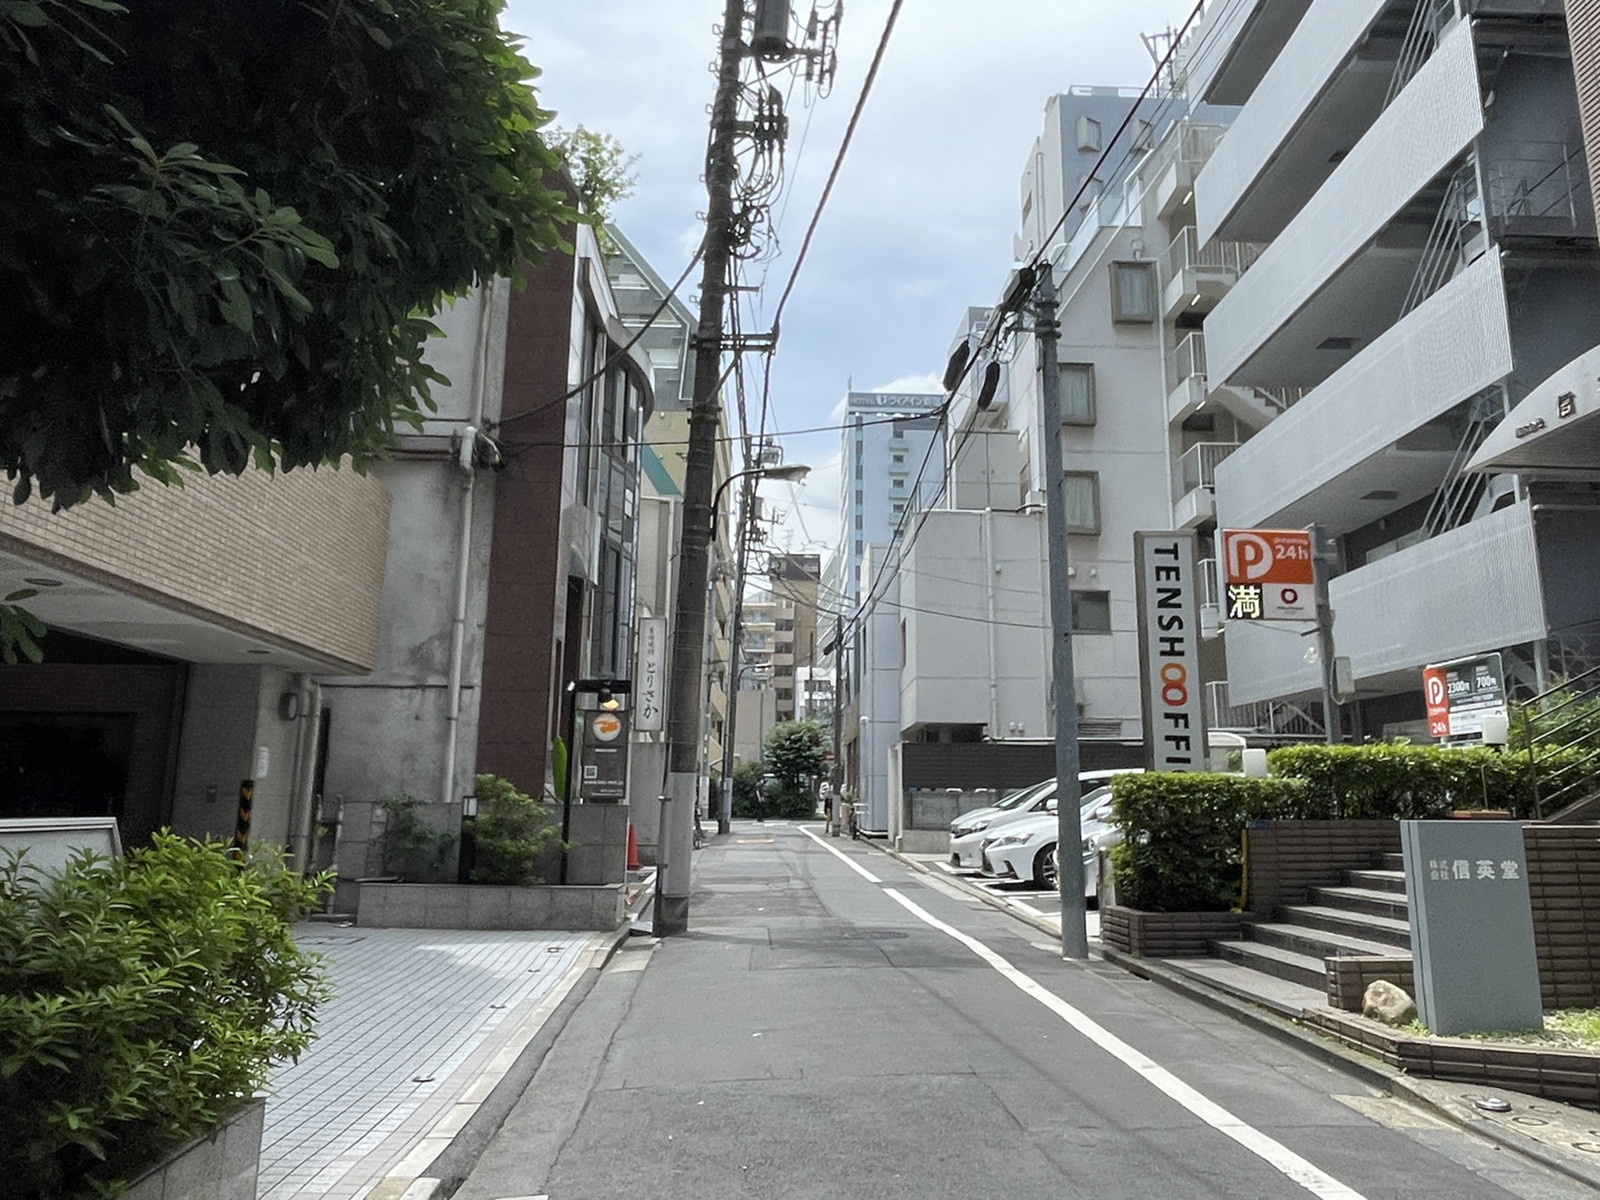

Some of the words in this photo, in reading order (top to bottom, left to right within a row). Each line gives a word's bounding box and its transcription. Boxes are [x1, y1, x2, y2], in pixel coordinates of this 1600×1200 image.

[1228, 533, 1273, 579] P
[1275, 544, 1309, 560] 24h
[1228, 585, 1261, 619] 満
[1153, 542, 1191, 772] TENSHOOFFI
[1428, 676, 1444, 705] P
[1432, 721, 1447, 734] 24h
[1451, 859, 1520, 880] 信英堂
